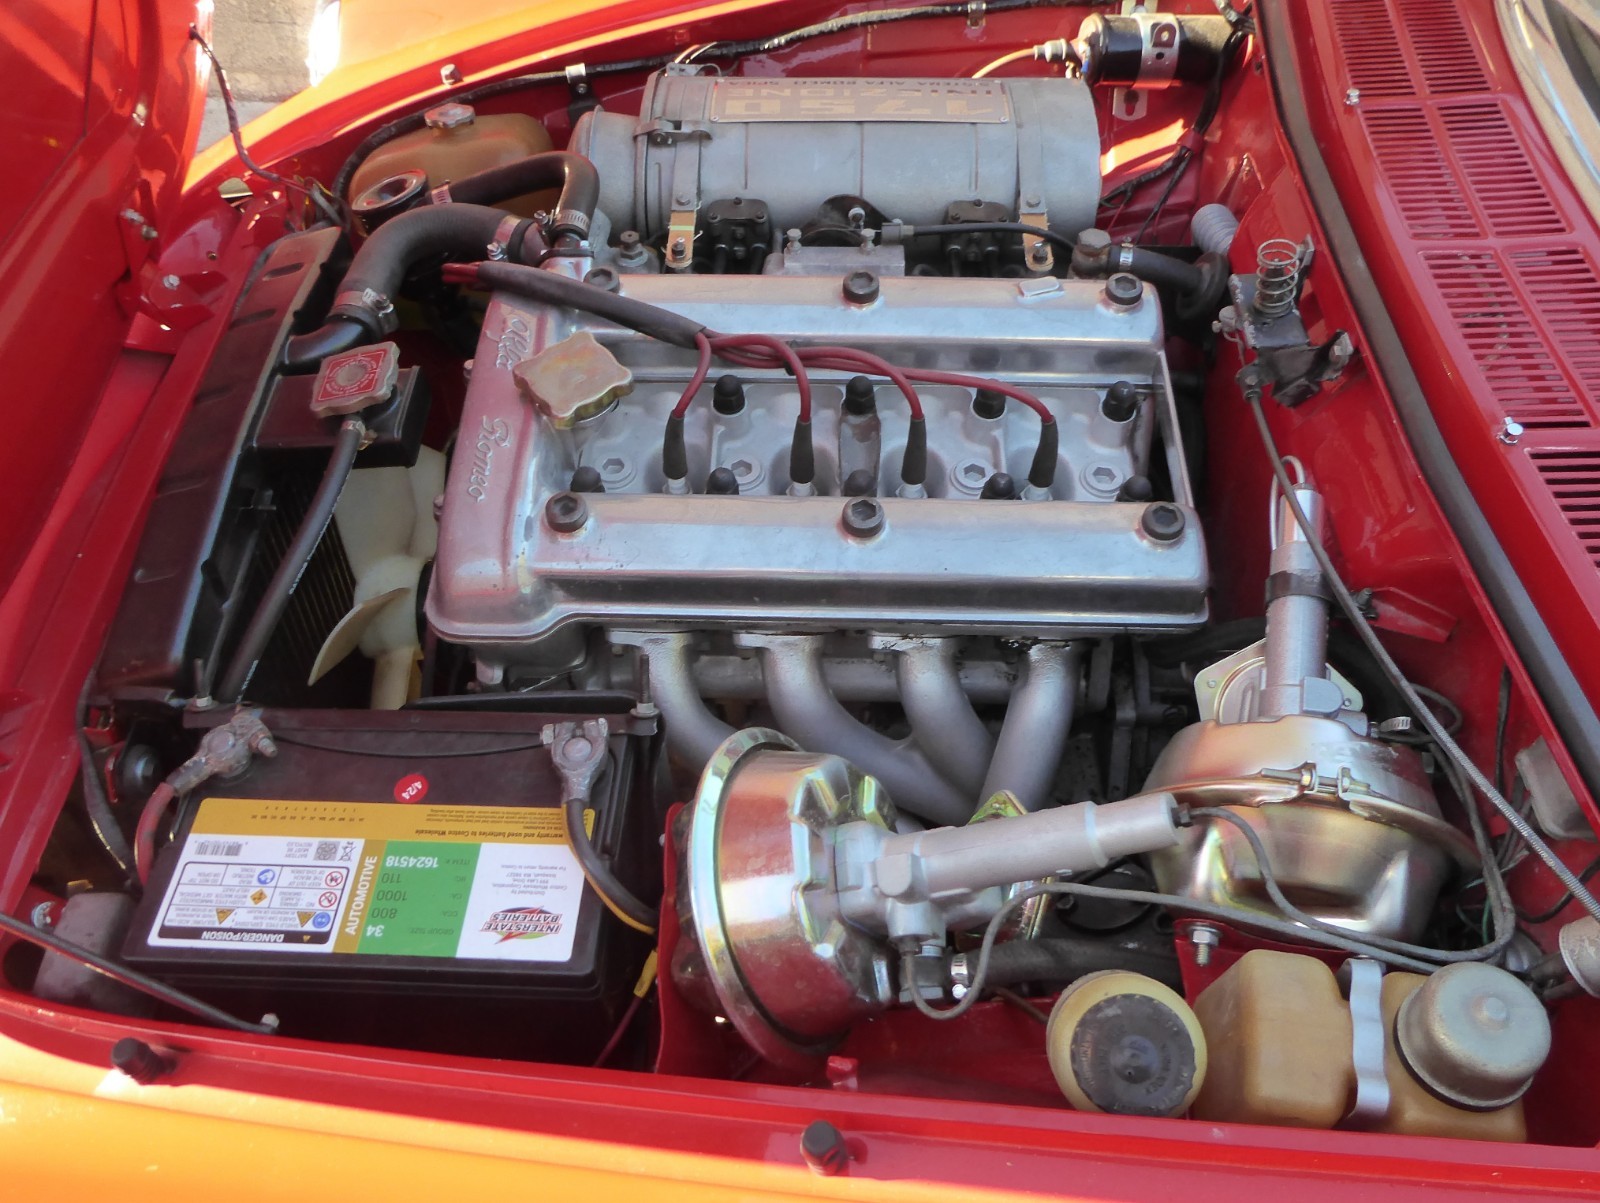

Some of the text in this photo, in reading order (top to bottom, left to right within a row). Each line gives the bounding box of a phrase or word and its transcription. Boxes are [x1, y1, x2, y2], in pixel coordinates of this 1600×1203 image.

[725, 99, 994, 115] 1750
[401, 780, 423, 800] 4/24
[386, 856, 439, 868] 1624518
[381, 873, 401, 883] 110
[344, 855, 377, 936] AUTOMOTIVE
[376, 890, 407, 901] 1000
[371, 908, 398, 919] 800
[491, 912, 560, 922] BATTERIES
[366, 925, 385, 937] 34
[483, 922, 560, 933] INTERSTATE
[201, 931, 285, 943] DANGER/POISON
